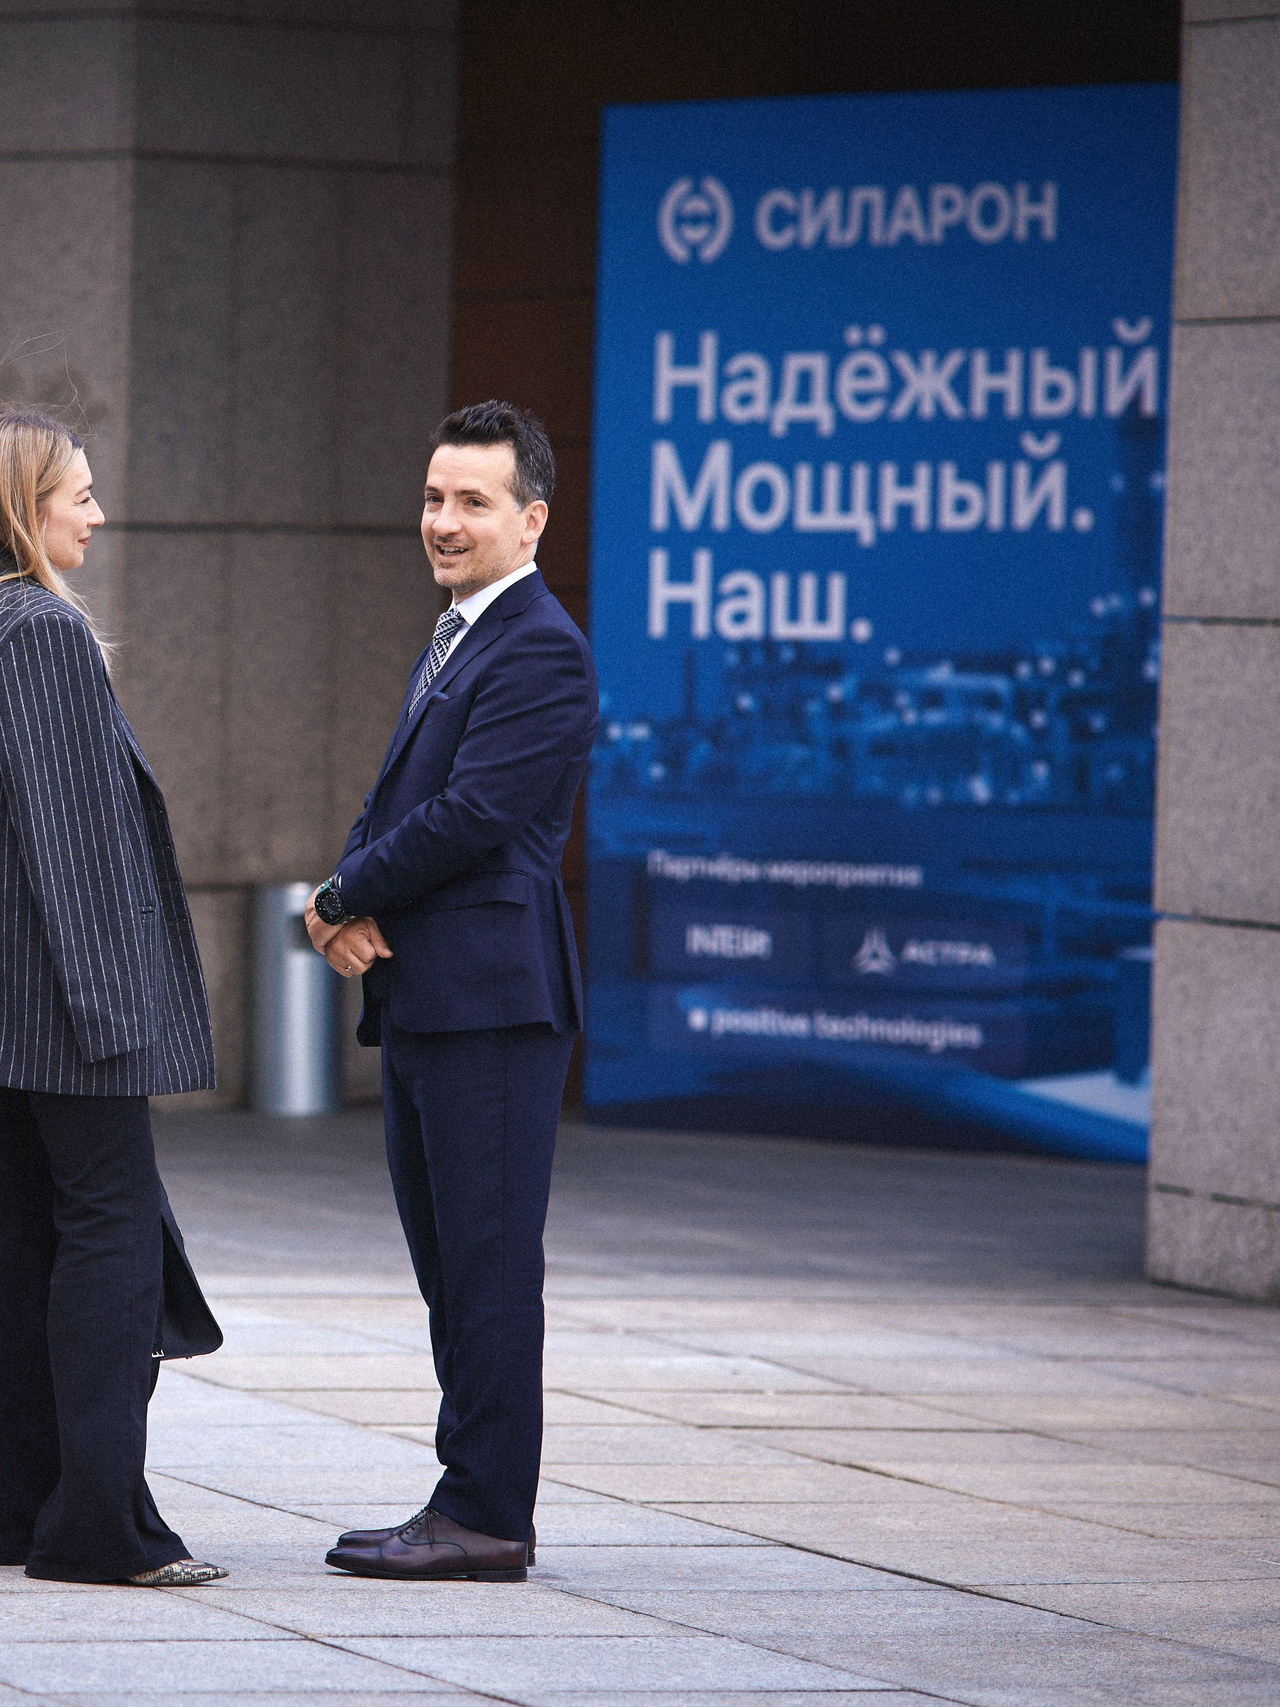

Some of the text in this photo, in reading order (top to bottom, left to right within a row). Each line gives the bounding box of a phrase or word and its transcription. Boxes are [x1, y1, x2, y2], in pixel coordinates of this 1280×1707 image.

[754, 181, 1058, 250] СИЛАРОН
[652, 316, 1160, 438] Надёжный
[650, 433, 1094, 547] Мощный.
[646, 547, 874, 641] Наш.
[711, 1006, 984, 1052] positive technologies
